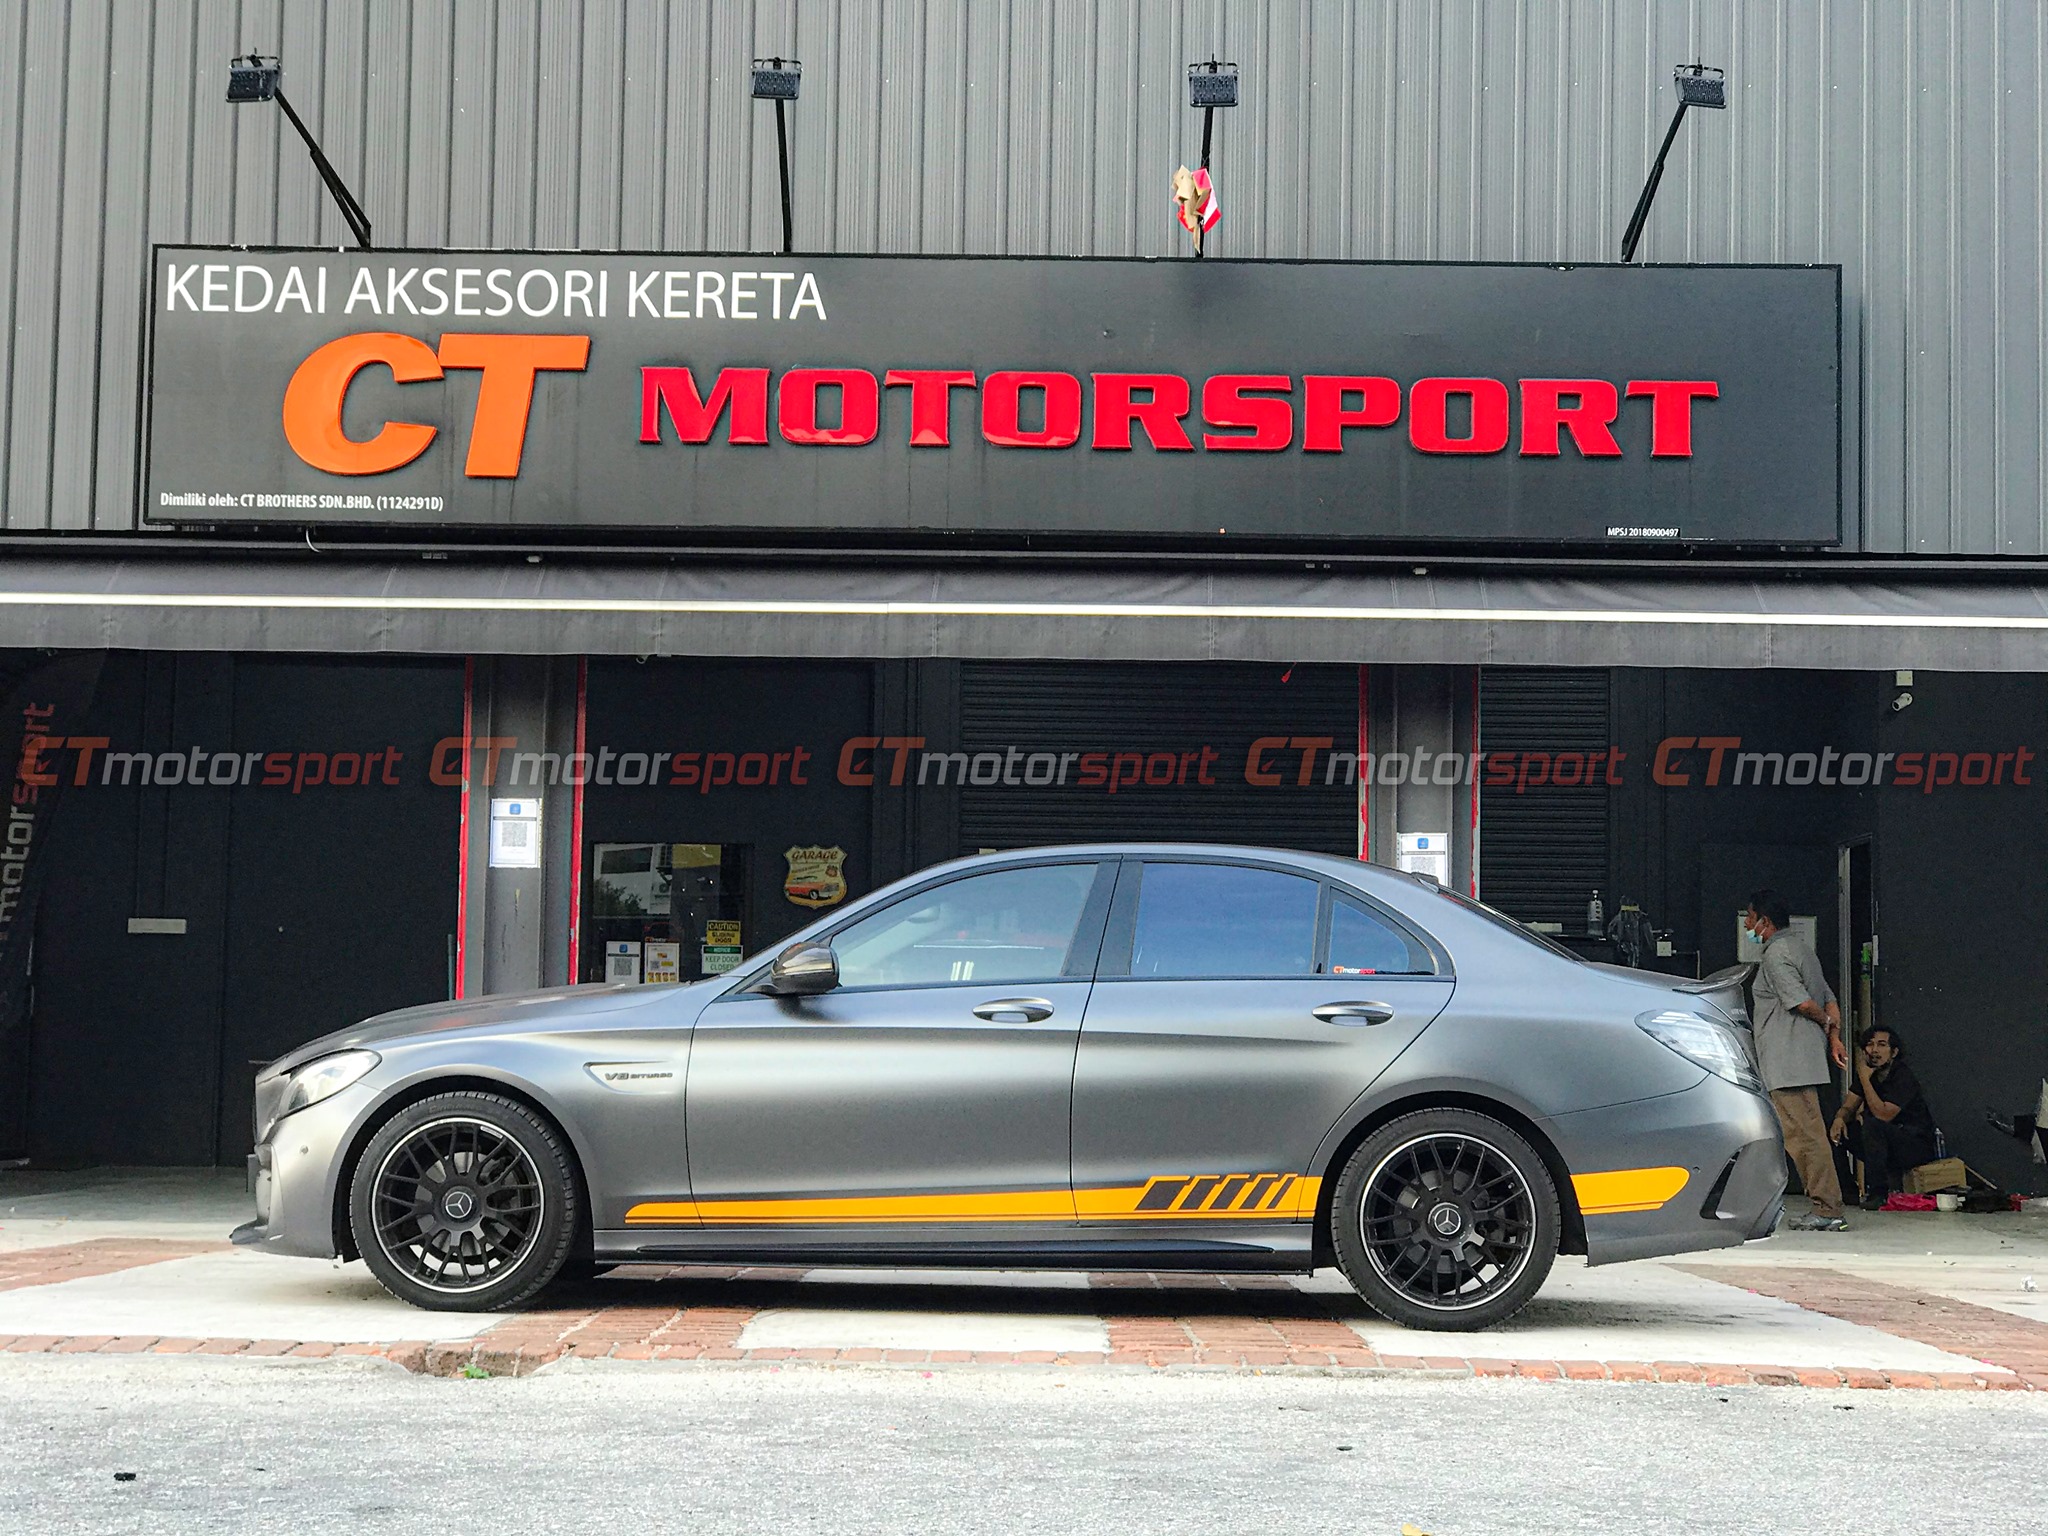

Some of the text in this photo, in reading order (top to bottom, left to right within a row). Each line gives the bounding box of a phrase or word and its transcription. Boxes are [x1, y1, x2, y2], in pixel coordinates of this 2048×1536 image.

[167, 263, 828, 321] KEDAI AKSESORI KERETA
[282, 331, 1720, 479] CT MOTORSPORT
[159, 492, 207, 507] Dimiliki
[208, 493, 239, 508] oleh:
[240, 494, 256, 508] CT
[256, 493, 318, 509] BROTHERS
[376, 495, 444, 512] (1124291D)
[1607, 527, 1679, 538] MPSJ 20180900497
[791, 850, 839, 860] GARAGE
[709, 922, 739, 930] CAUTION
[705, 955, 721, 963] KEEP
[604, 1072, 629, 1081] V8
